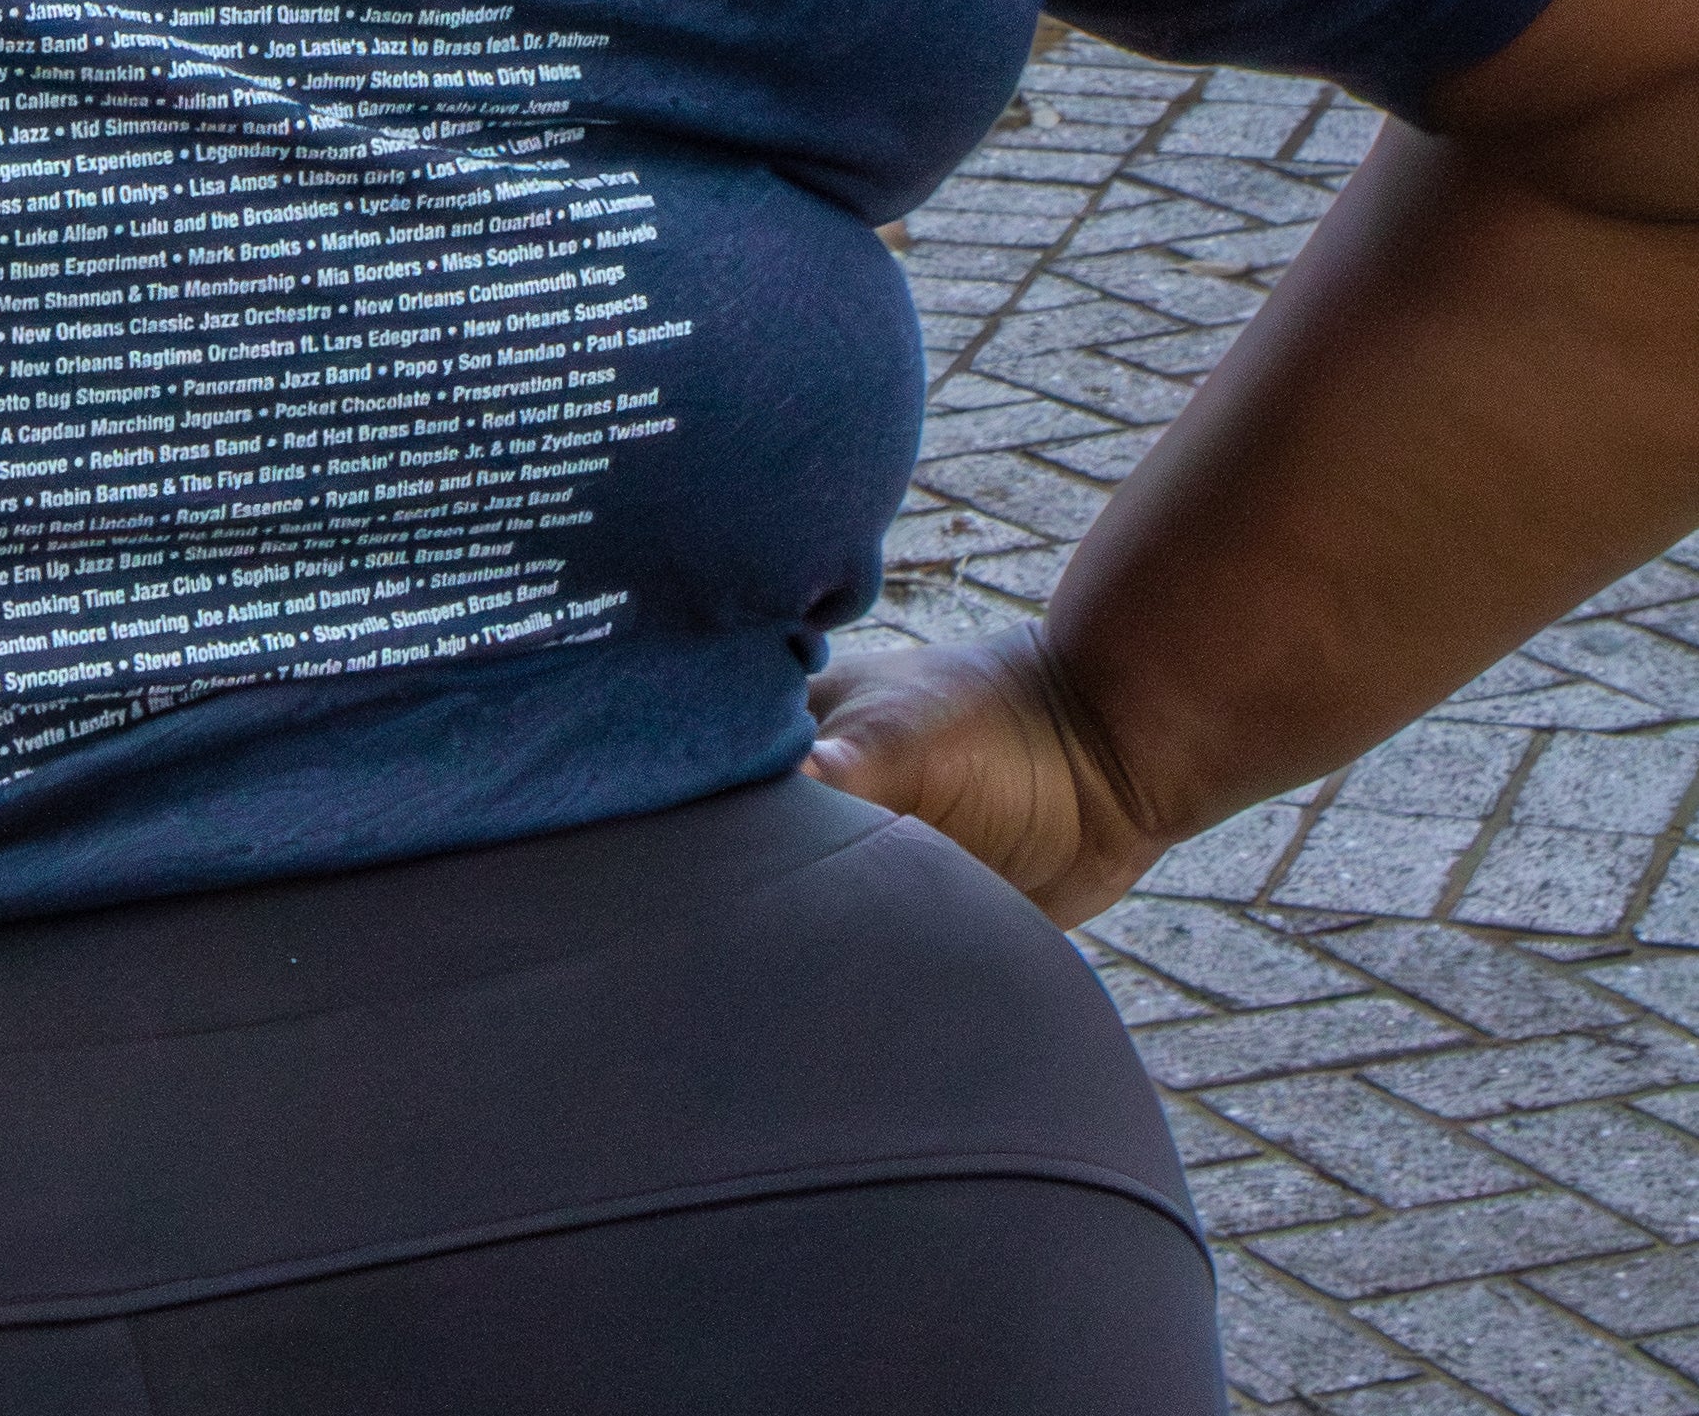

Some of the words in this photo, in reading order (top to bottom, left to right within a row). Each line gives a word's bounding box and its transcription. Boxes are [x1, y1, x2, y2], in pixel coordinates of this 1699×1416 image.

[76, 150, 173, 174] Experience
[386, 223, 445, 244] Jordan
[240, 239, 301, 261] Brooks
[354, 261, 422, 282] Borders
[130, 314, 194, 334] Classic
[129, 348, 202, 370] Ragtime
[3, 595, 80, 619] Smoking
[5, 661, 114, 693] Syncopators
